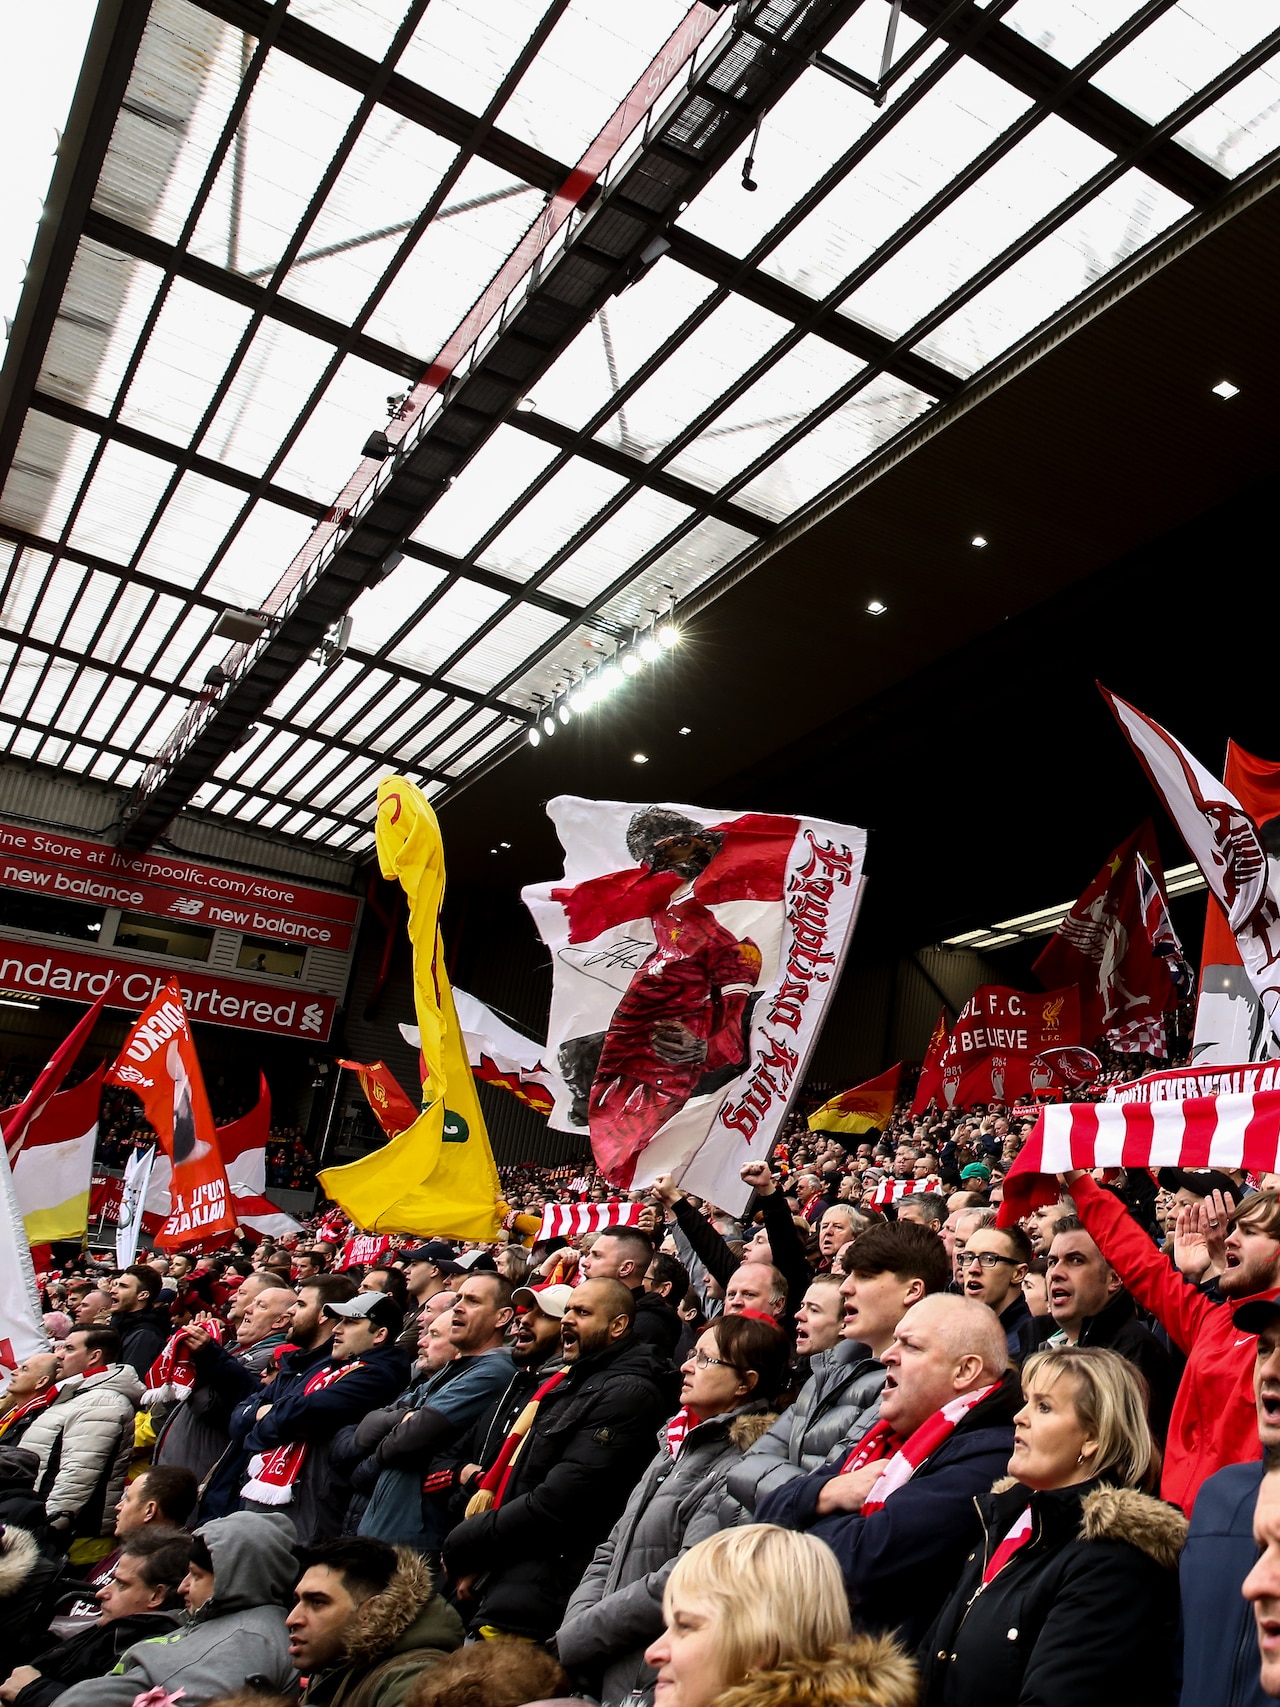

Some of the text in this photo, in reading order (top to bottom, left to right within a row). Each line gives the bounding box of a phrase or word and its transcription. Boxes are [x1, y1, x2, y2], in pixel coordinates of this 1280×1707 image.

[4, 865, 144, 905] new balance
[32, 836, 82, 859] Store
[87, 850, 105, 864] at
[110, 853, 295, 903] liverpoolfc.com/store
[208, 904, 250, 926] new
[252, 909, 332, 942] balance
[718, 829, 853, 1146] Egyptian King
[961, 1028, 1028, 1052] BELIEVE
[1149, 1077, 1199, 1103] NEVER
[1198, 1069, 1256, 1098] WALK
